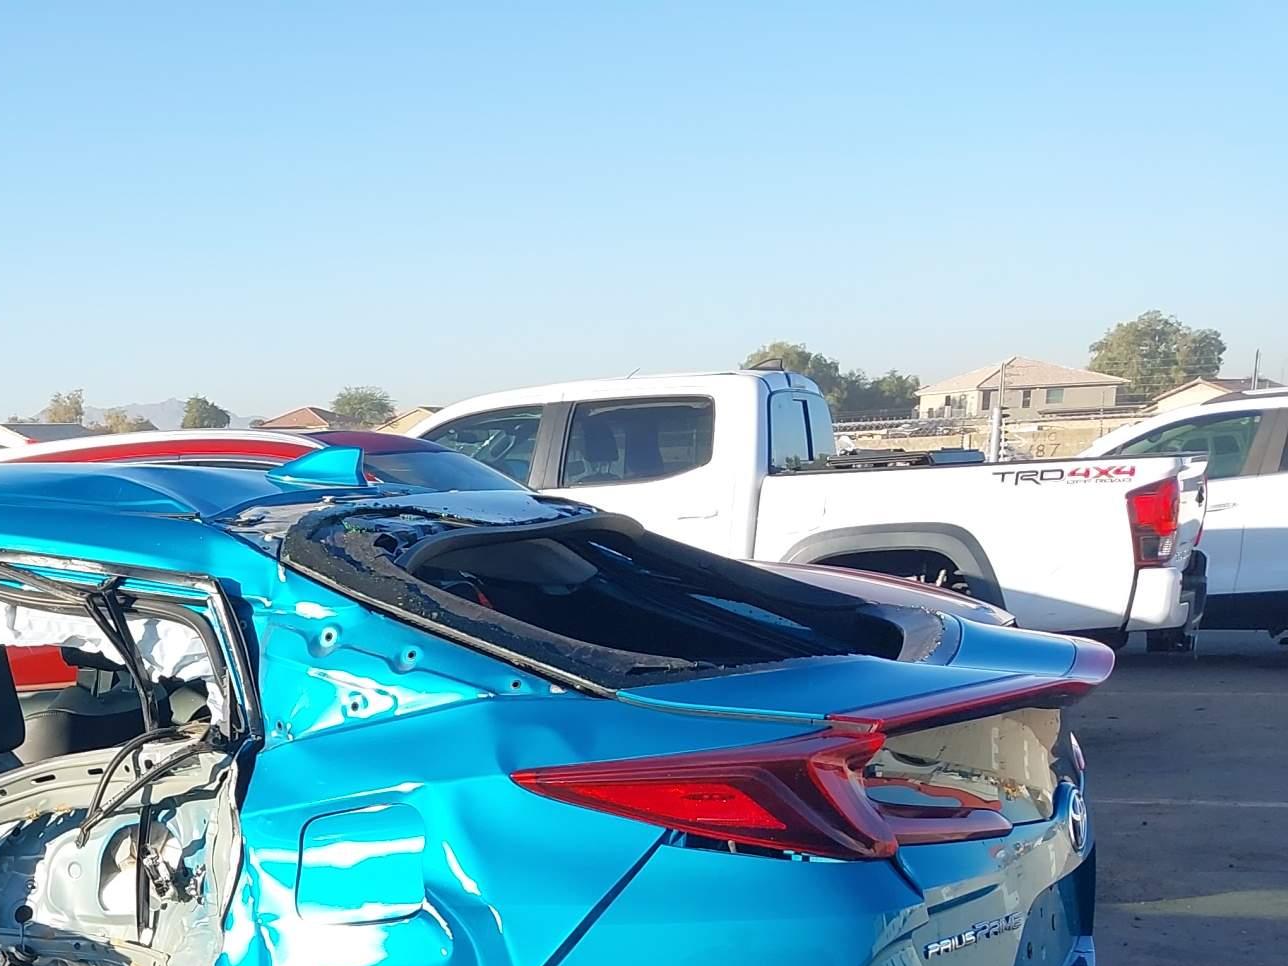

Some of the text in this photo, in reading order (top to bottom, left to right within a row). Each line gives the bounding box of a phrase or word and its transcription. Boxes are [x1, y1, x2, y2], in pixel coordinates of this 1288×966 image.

[992, 468, 1064, 486] TRD
[924, 912, 1024, 959] PRIUS PRIME
